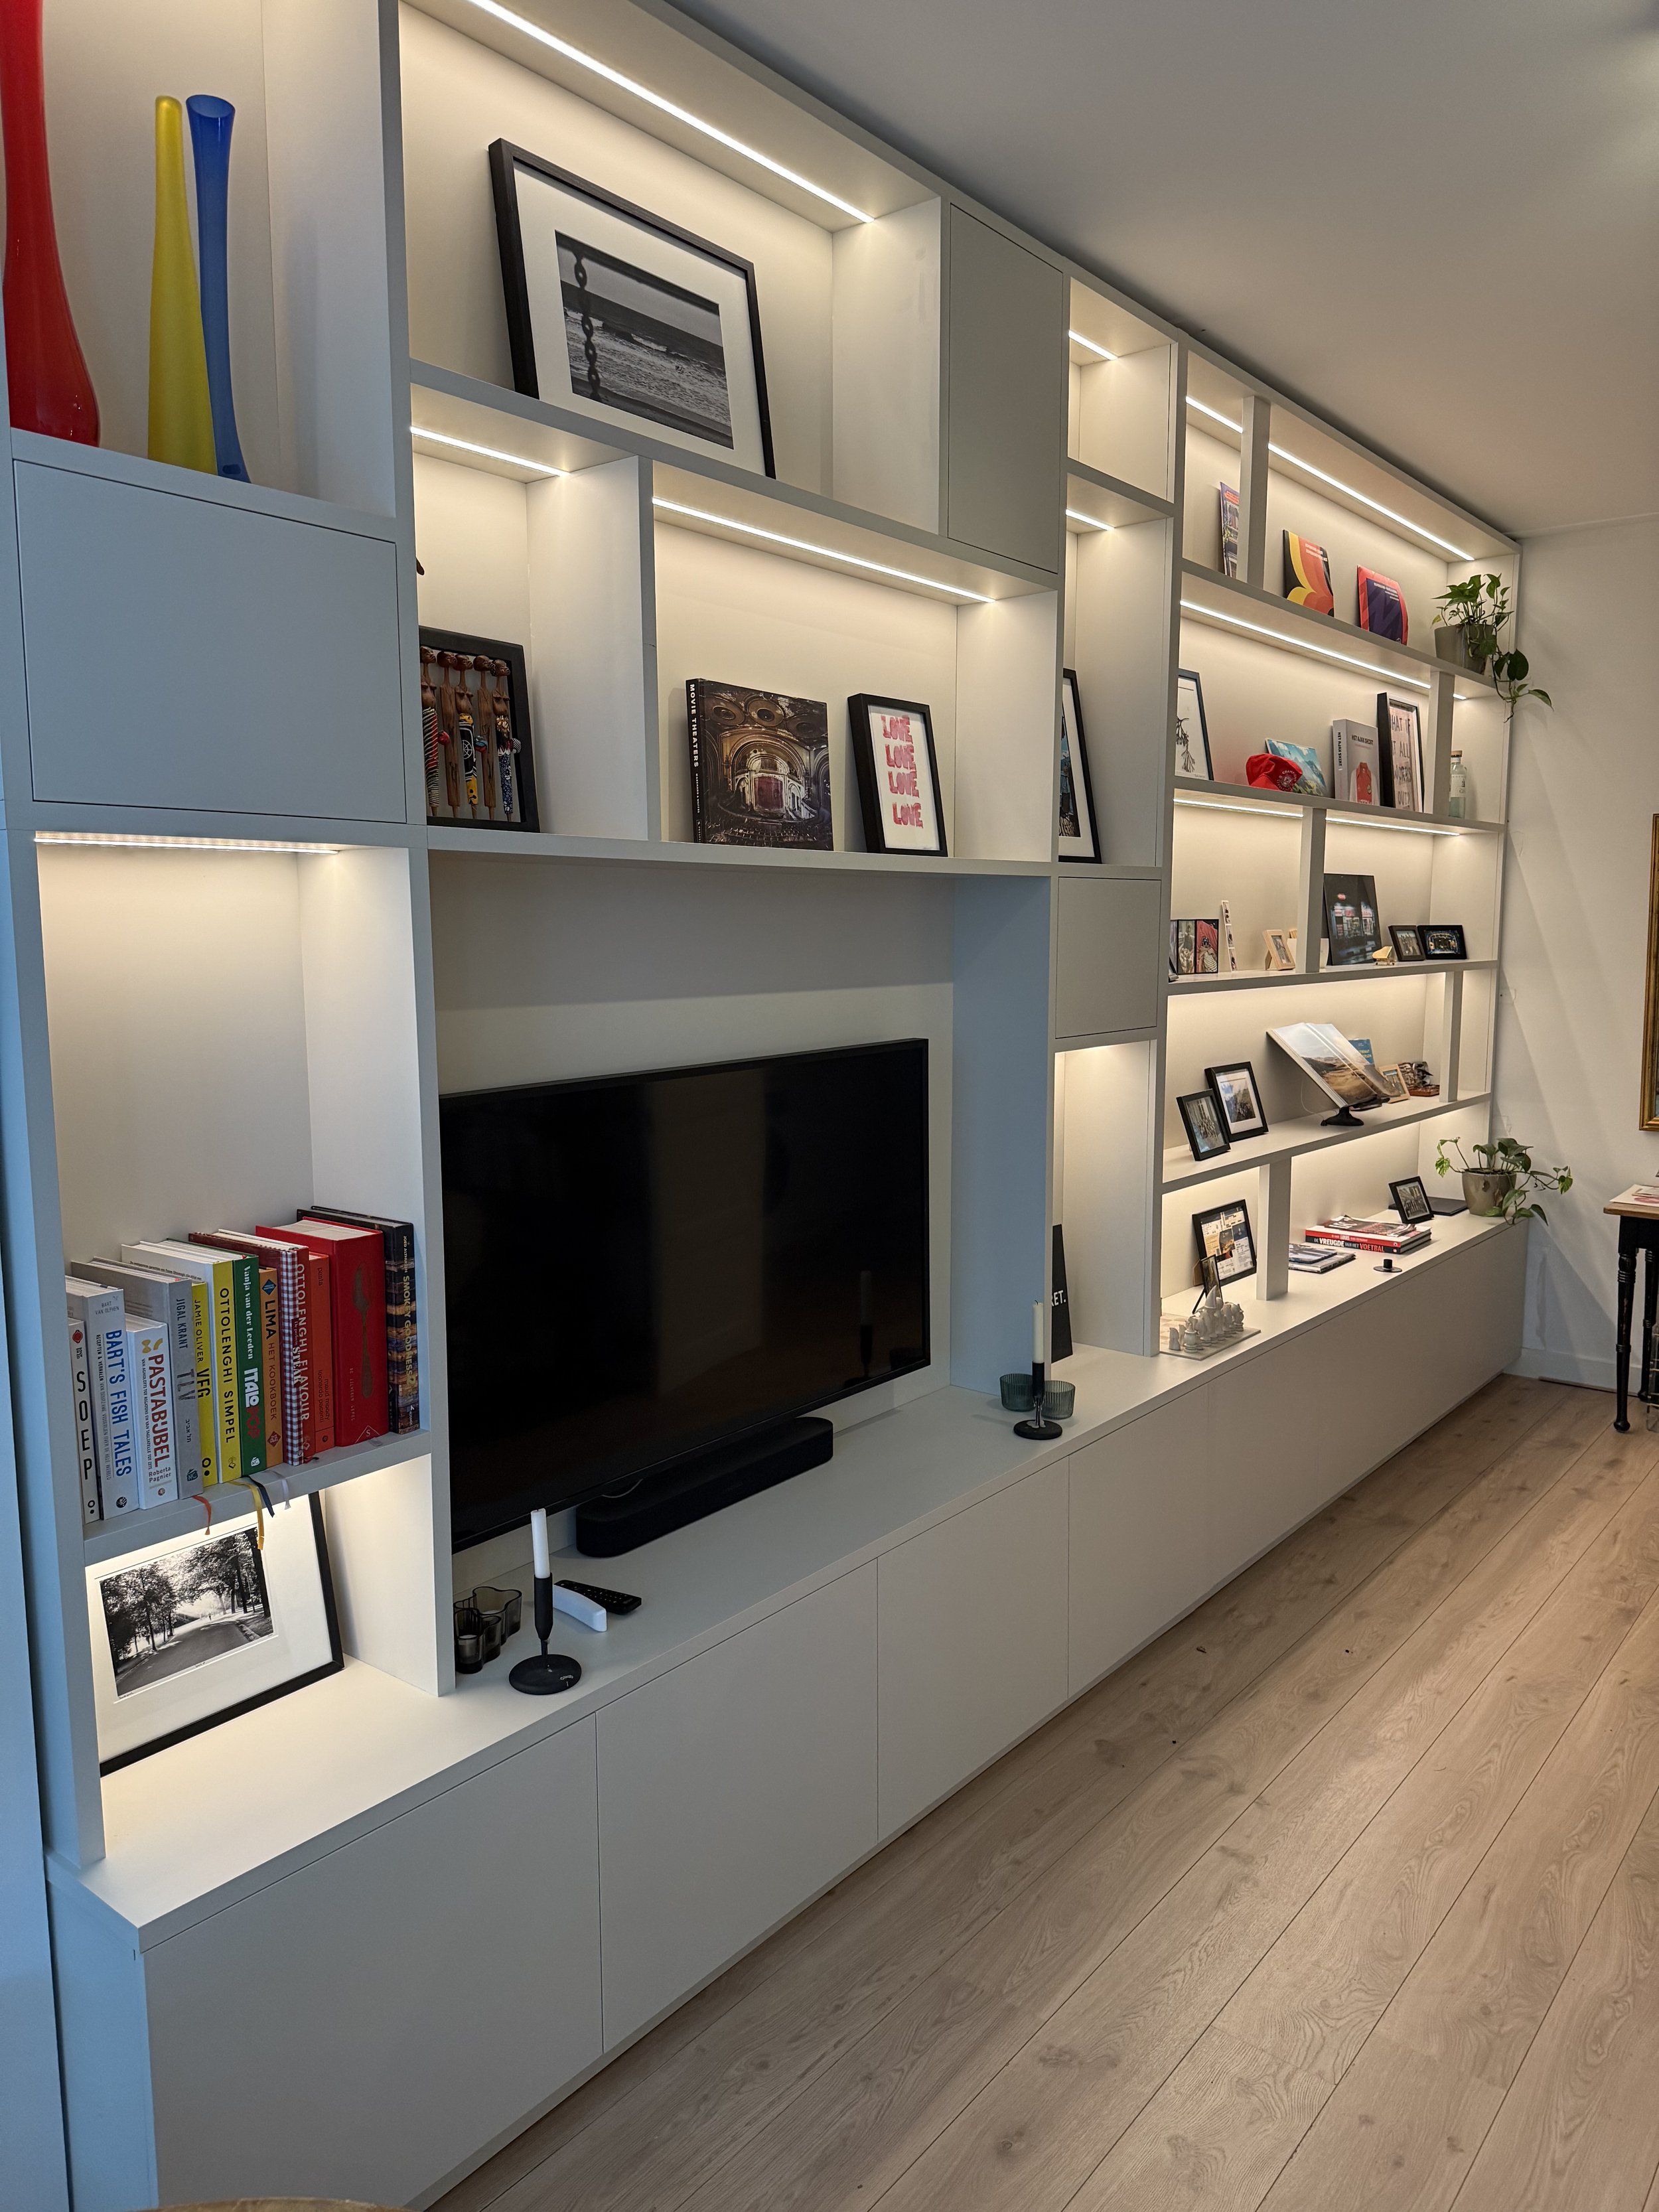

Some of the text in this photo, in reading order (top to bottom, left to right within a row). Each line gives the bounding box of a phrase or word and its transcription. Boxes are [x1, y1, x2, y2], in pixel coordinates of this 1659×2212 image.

[881, 714, 913, 744] LOVE
[1391, 714, 1402, 732] HAT
[885, 744, 917, 771] LOVE
[1400, 741, 1409, 758] ALL
[888, 771, 920, 798] LOVE
[892, 802, 924, 828] LOVE
[1319, 1237, 1344, 1248] VREUGDE
[1360, 1243, 1385, 1253] VOETBAL
[177, 1298, 188, 1349] JIGAL KRANT
[265, 1299, 276, 1339] LIMA
[195, 1329, 204, 1363] OLIVER
[220, 1288, 235, 1443] OTTOLENGHI SIMPEL
[177, 1368, 195, 1400] TLV
[196, 1368, 211, 1398] VEG
[269, 1364, 277, 1420] KOOKBOEK
[106, 1330, 132, 1477] BART'S FISH TALES
[77, 1370, 93, 1480] SOEP
[149, 1467, 171, 1477] Roberta
[149, 1472, 172, 1483] Pagnier
